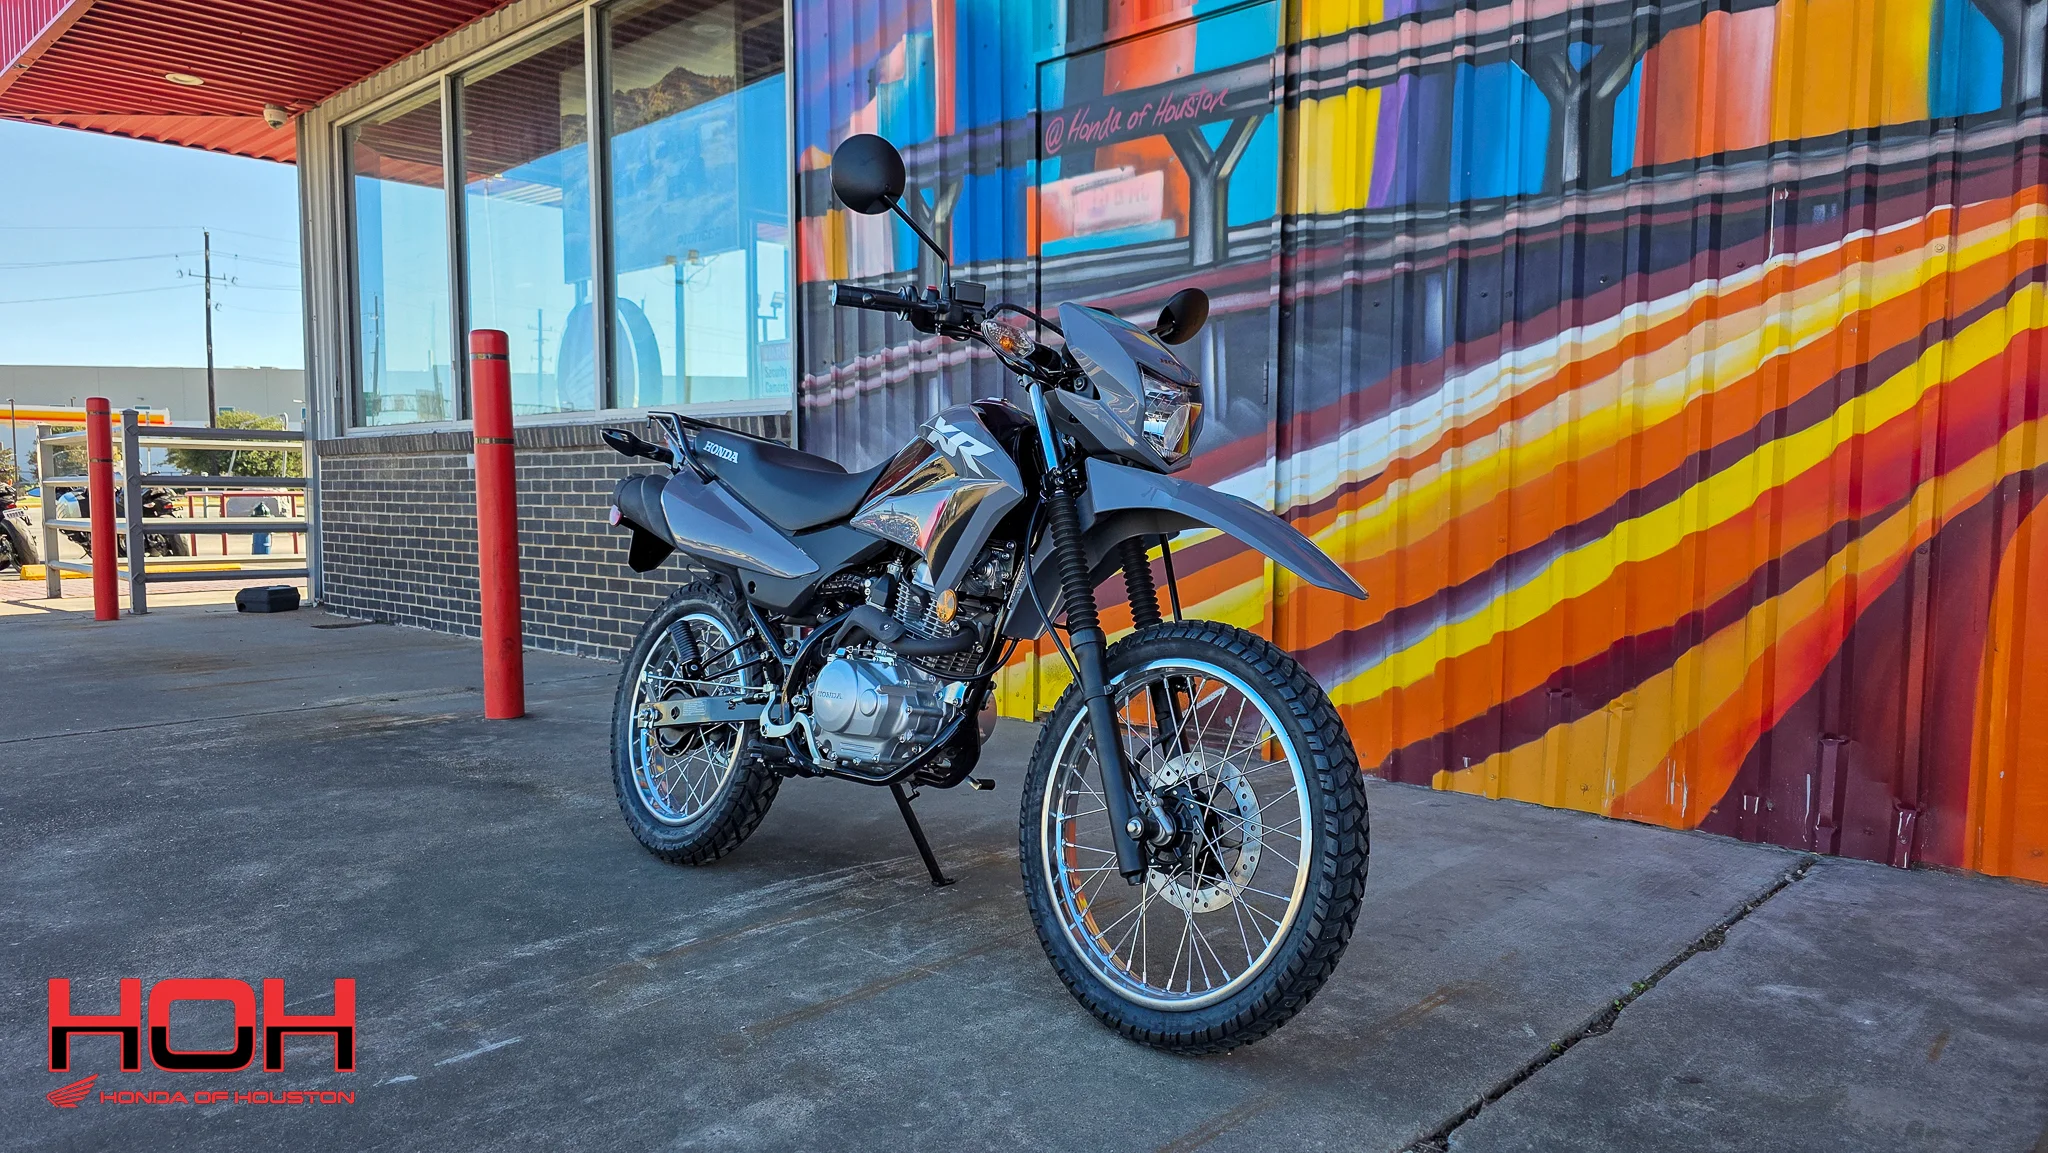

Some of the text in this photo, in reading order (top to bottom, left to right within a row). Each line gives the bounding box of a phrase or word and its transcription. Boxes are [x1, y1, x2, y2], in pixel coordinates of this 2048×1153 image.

[1045, 84, 1229, 154] @ Honda of Houston
[764, 365, 787, 380] Security
[765, 381, 789, 393] Cameras
[703, 440, 739, 463] HONDA
[926, 415, 995, 478] XR
[817, 690, 843, 700] HONDA
